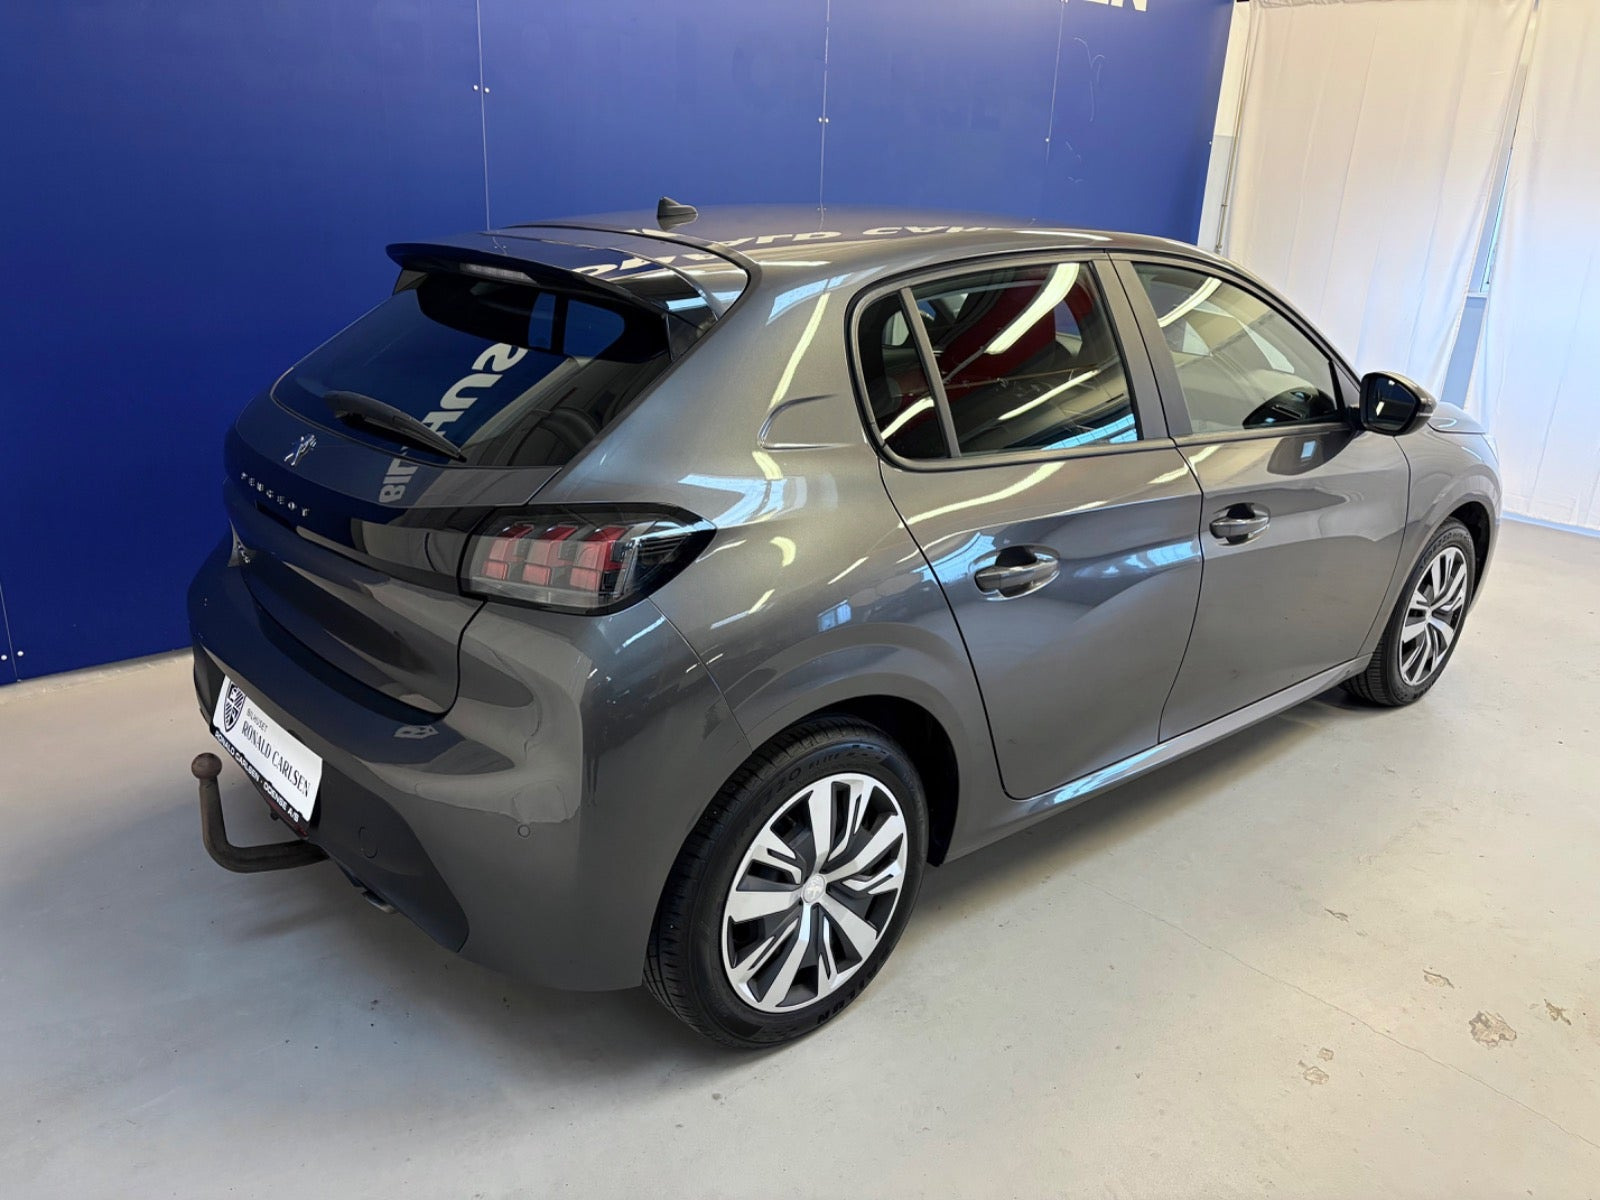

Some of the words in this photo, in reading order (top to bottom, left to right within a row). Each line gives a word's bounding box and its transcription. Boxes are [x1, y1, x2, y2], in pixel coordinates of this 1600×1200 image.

[240, 471, 310, 517] PEUGEOT
[214, 730, 235, 757] RONALD
[235, 752, 260, 782] CARLSEN
[241, 720, 272, 759] RONALD
[271, 751, 311, 798] CARLSEN
